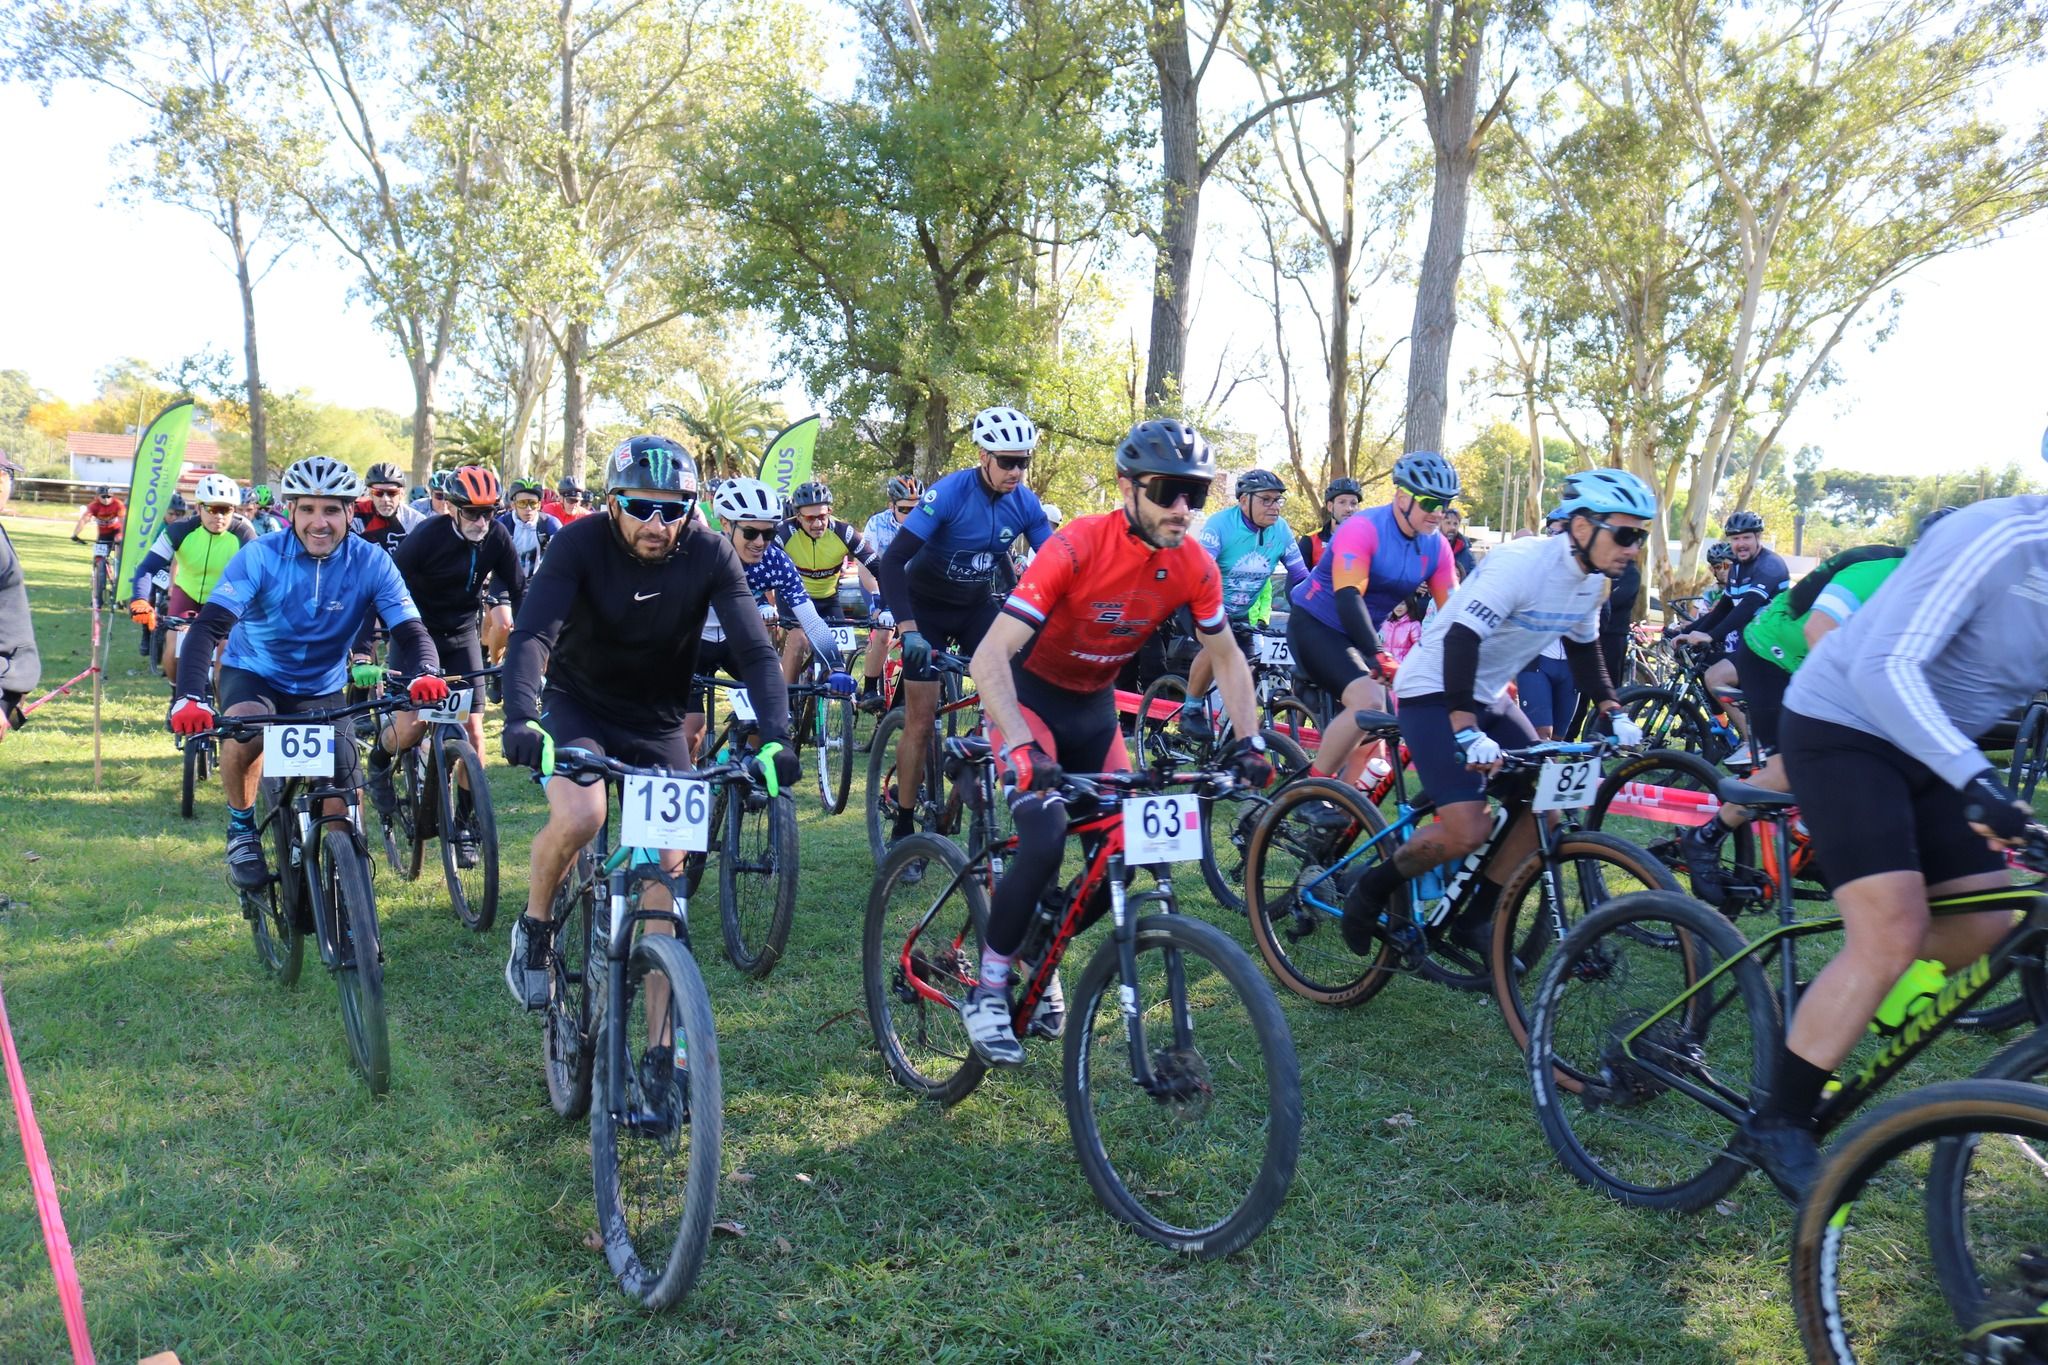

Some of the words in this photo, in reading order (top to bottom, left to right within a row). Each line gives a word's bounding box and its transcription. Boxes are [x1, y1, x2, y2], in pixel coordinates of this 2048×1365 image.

[1272, 642, 1288, 659] 75
[281, 727, 321, 758] 65
[1557, 763, 1590, 792] 82
[638, 780, 705, 825] 136
[1143, 799, 1181, 839] 63
